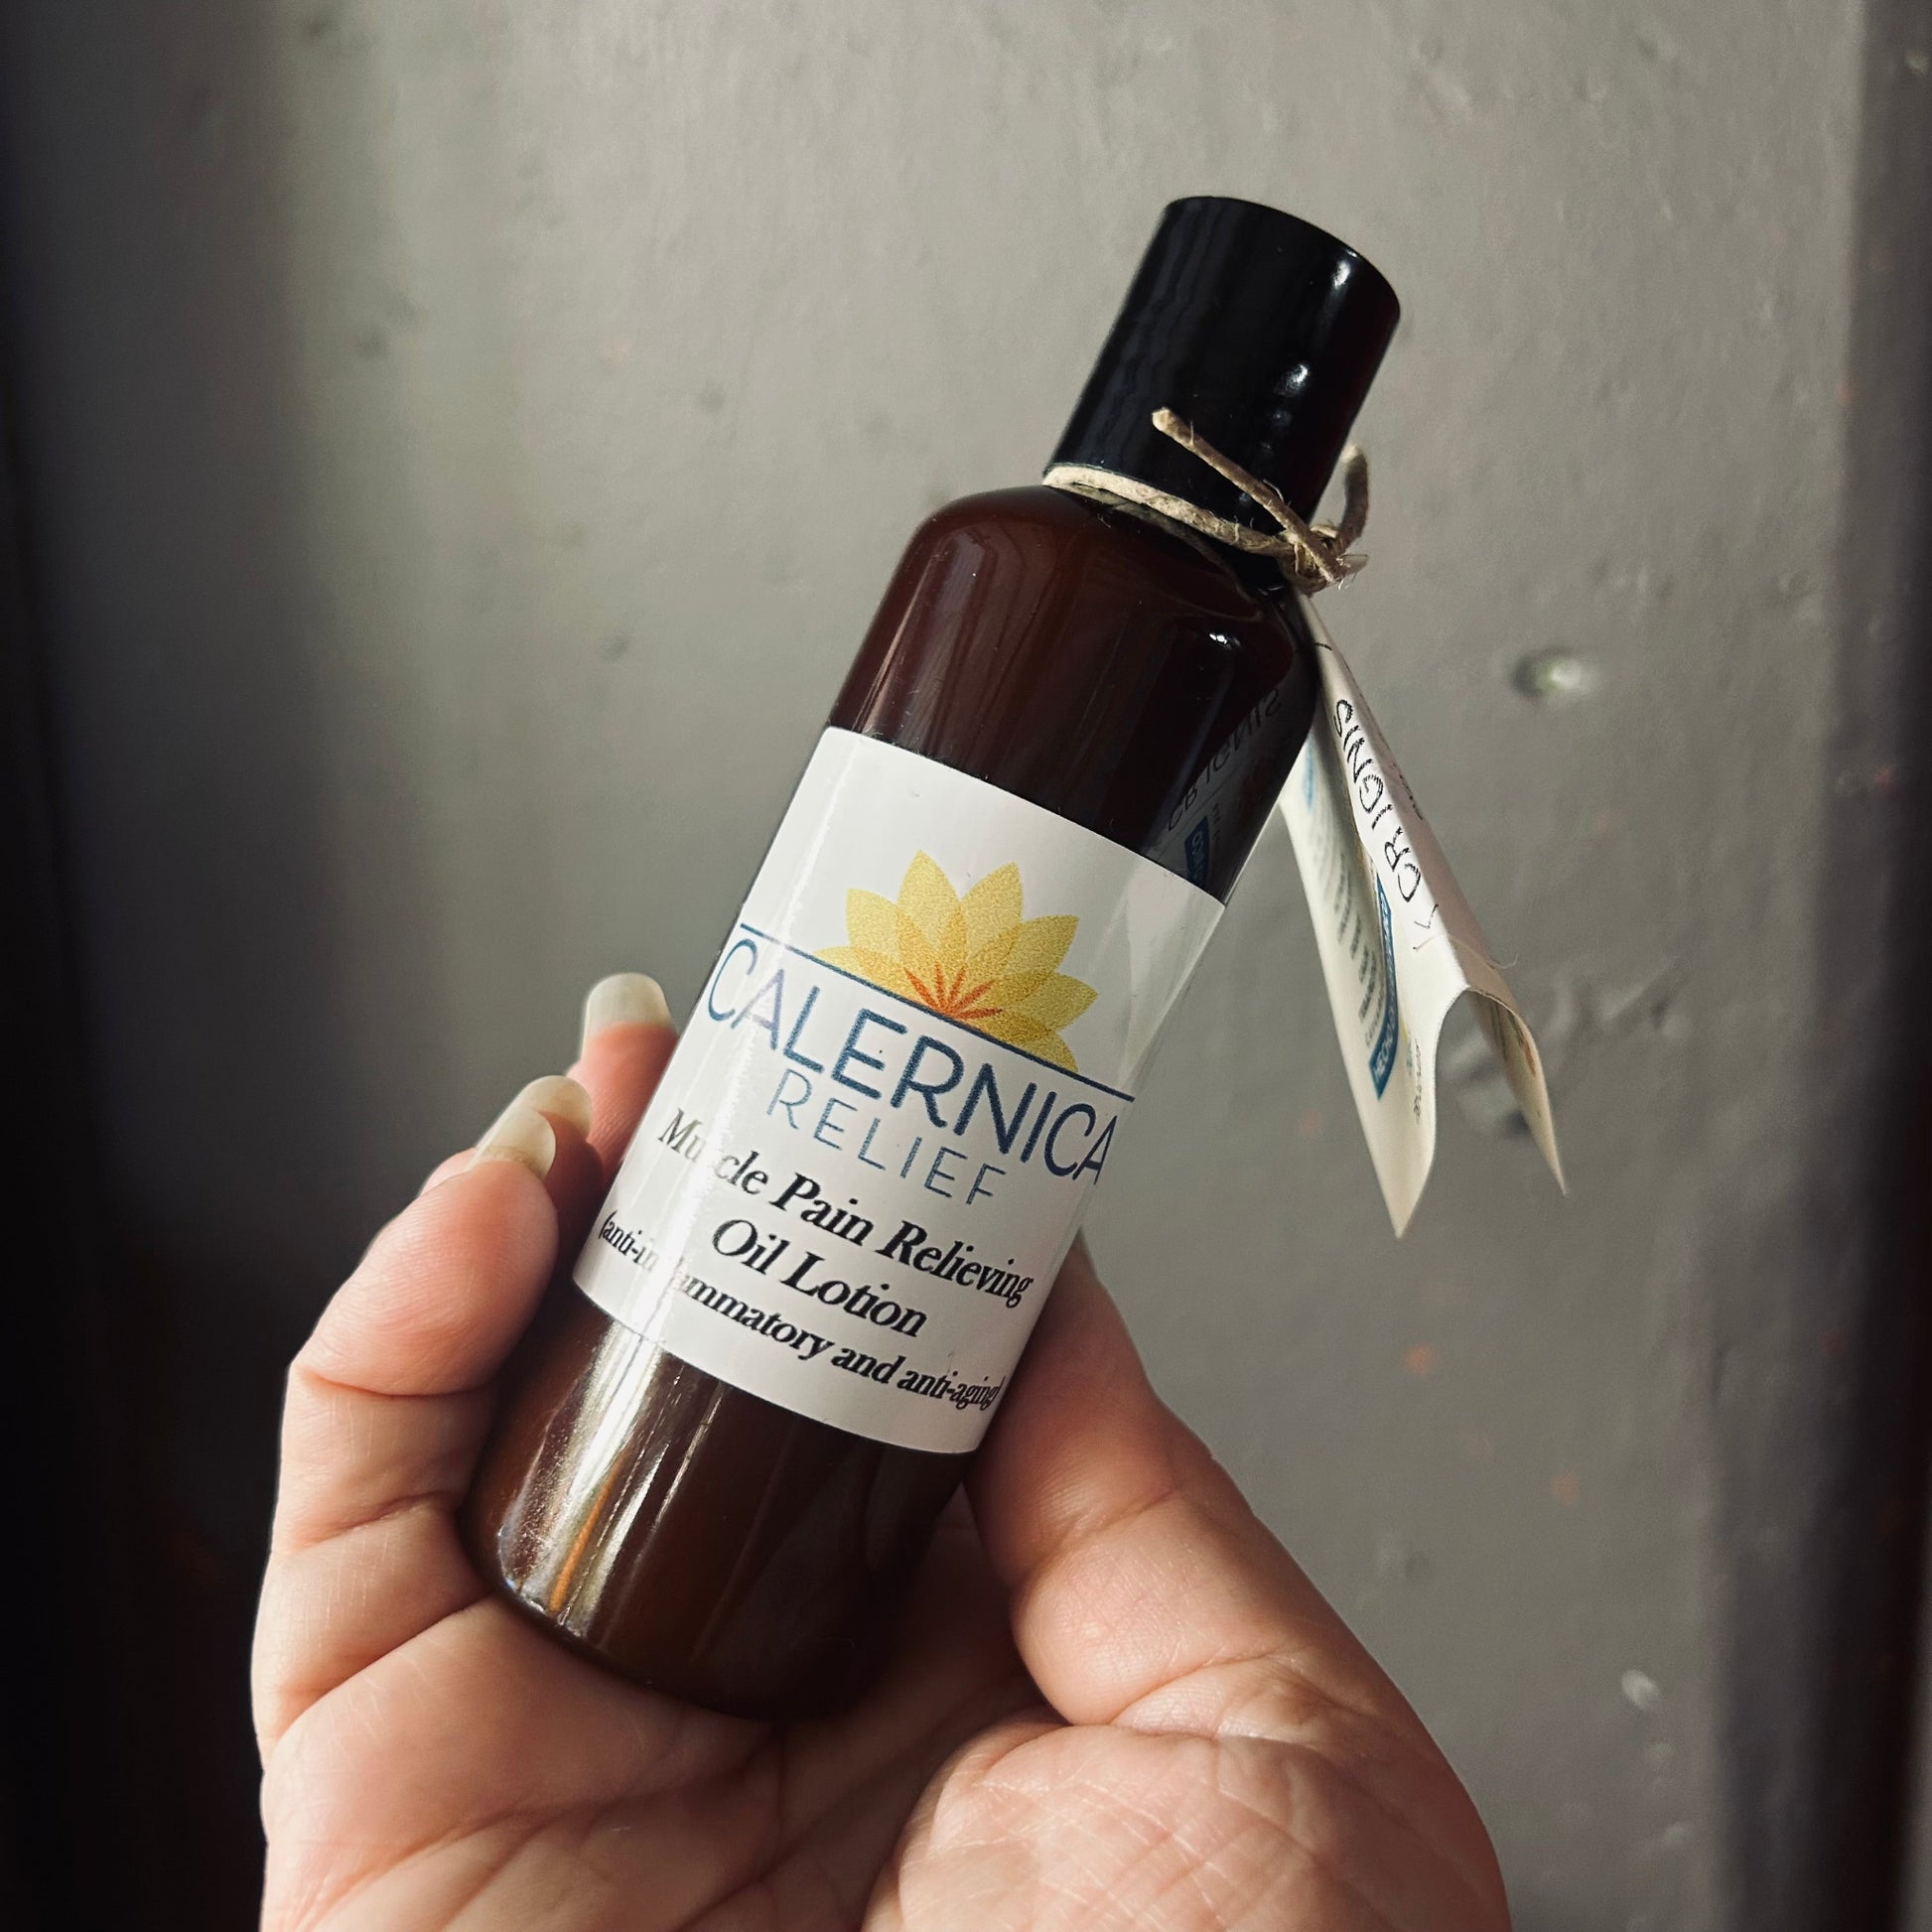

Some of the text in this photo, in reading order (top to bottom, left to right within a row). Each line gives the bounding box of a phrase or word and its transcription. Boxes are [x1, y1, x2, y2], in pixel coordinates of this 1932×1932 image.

[708, 938, 1118, 1185] CALERNICA
[766, 1068, 1007, 1205] RELIEF
[657, 1108, 1035, 1309] Mucle Pain Relieving
[712, 1219, 926, 1337] Oil Lotion
[831, 1347, 906, 1384] and
